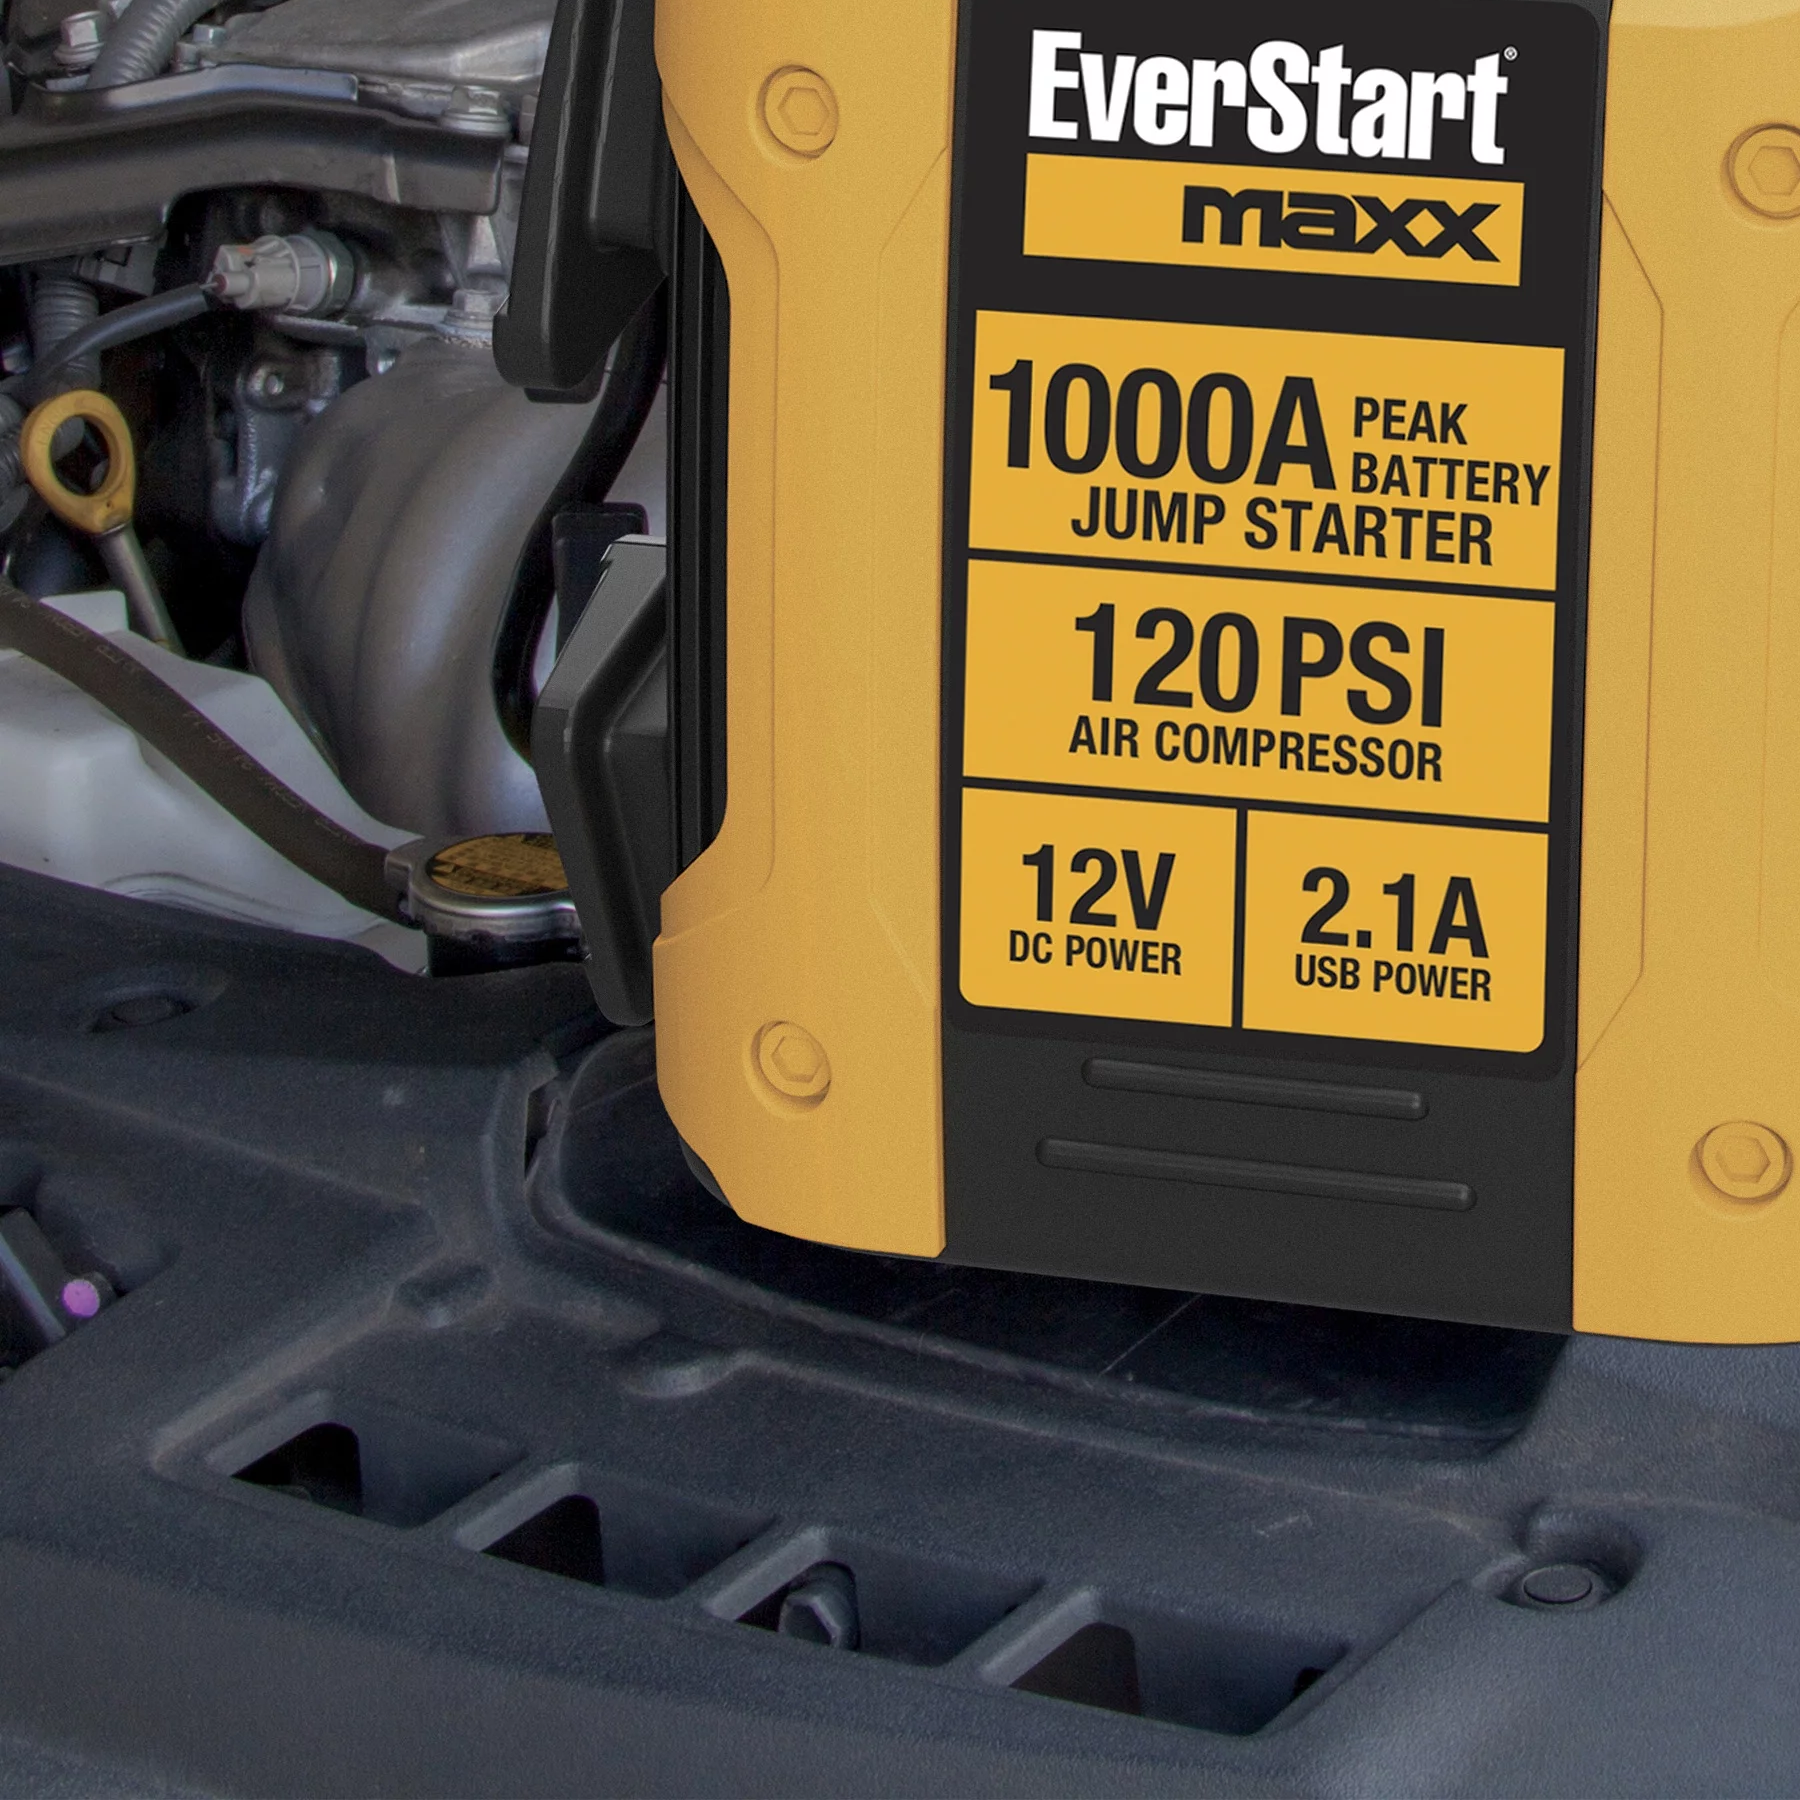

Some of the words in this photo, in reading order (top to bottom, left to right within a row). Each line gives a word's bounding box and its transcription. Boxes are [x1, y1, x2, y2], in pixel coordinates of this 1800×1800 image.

[1028, 29, 1509, 165] EverStart
[1181, 184, 1502, 263] maxx
[988, 358, 1337, 491] 1000A
[1352, 395, 1468, 446] PEAK
[1350, 451, 1550, 507] BATTERY
[1070, 485, 1226, 545] JUMP
[1243, 495, 1494, 567] STARTER
[1074, 602, 1260, 714] 120
[1280, 615, 1445, 728] PSI
[1068, 714, 1139, 759] AIR
[1154, 720, 1443, 783] COMPRESSOR
[1021, 843, 1177, 932] 12V
[1299, 865, 1490, 959] 2.1A
[1008, 929, 1053, 963] DC
[1065, 934, 1182, 976] POWER
[1294, 953, 1360, 990] USB
[1372, 959, 1492, 1002] POWER
